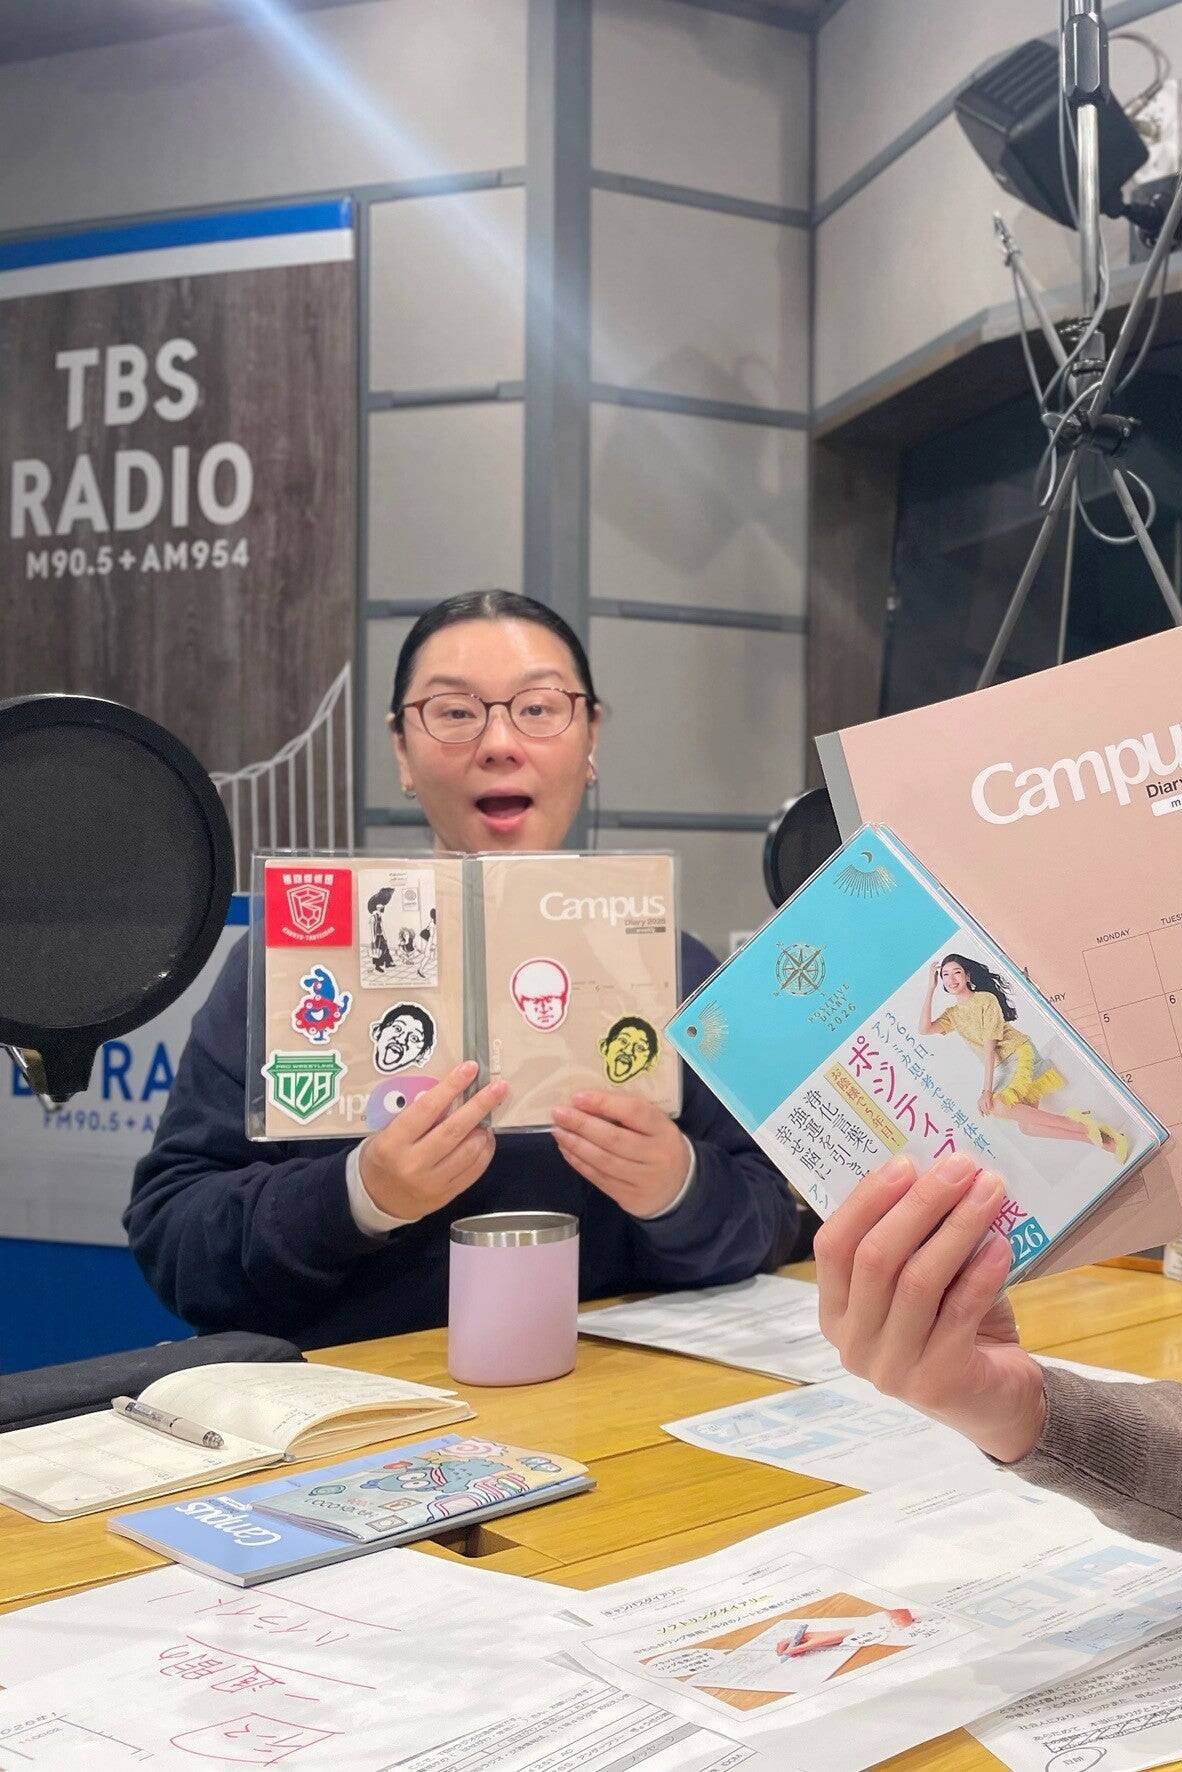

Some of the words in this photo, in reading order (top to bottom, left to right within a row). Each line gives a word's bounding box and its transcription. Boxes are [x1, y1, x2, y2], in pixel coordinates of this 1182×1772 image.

[56, 338, 199, 431] TBS
[10, 441, 253, 539] RADIO
[539, 891, 666, 926] Campus
[1096, 928, 1131, 944] MONDAY
[827, 1004, 857, 1033] 2026
[1103, 1013, 1110, 1023] 5
[1169, 994, 1176, 1004] 6
[802, 1089, 878, 1156] 浄化言葉で
[776, 1125, 831, 1181] 幸せ脳に
[174, 1501, 282, 1548] Campus
